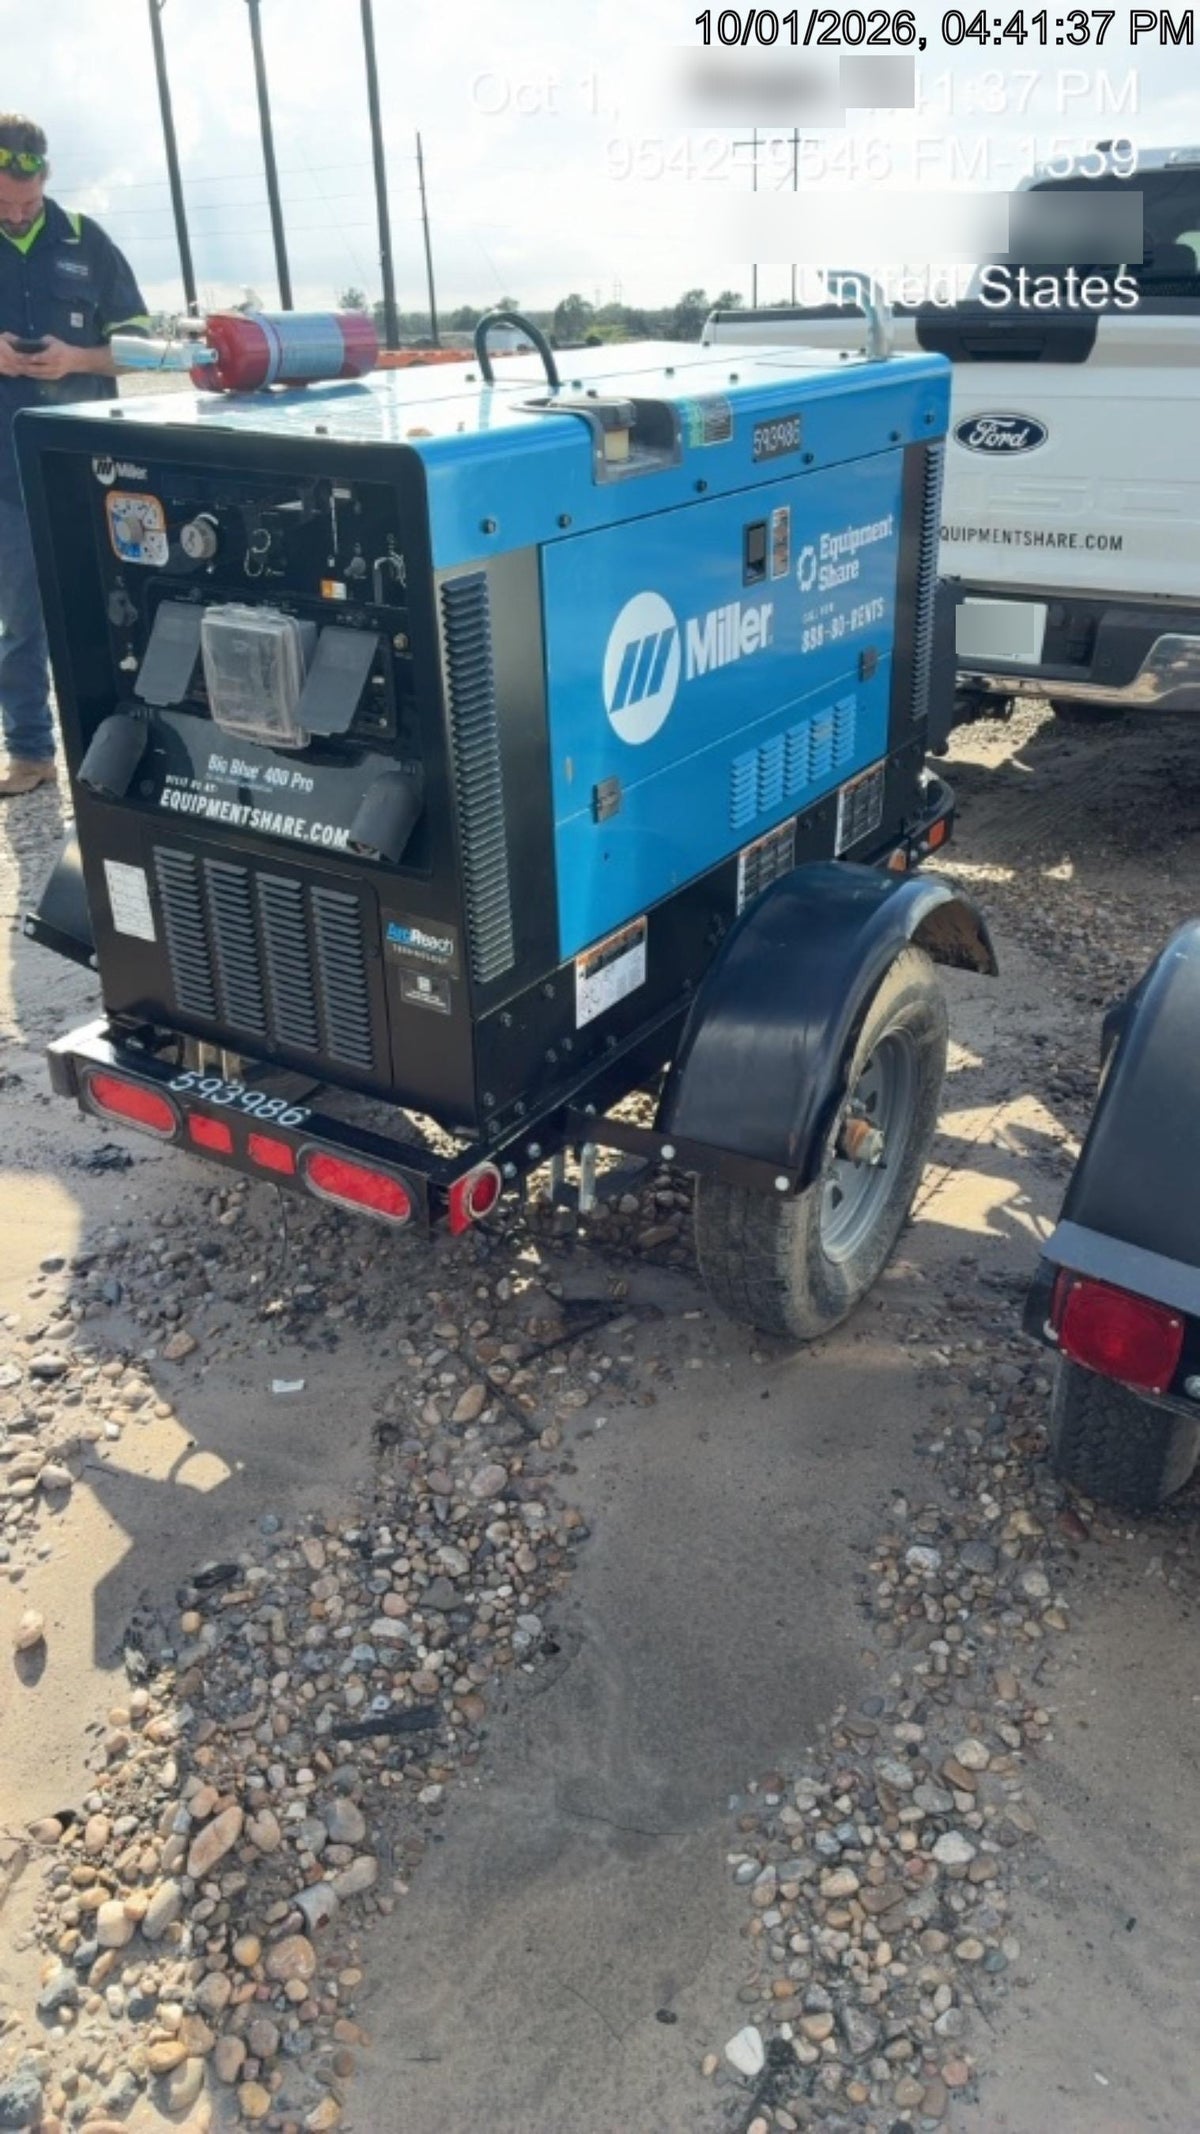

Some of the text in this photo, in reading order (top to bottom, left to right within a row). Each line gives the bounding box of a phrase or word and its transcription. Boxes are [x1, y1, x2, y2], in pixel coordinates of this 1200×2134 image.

[968, 420, 1030, 448] Ford
[114, 461, 148, 480] Miller
[820, 513, 893, 562] Equipment
[937, 526, 1123, 551] QUIPMENTSHARE.COM
[818, 559, 860, 591] Share
[685, 602, 774, 681] Miller
[208, 753, 228, 774] Big
[263, 766, 289, 787] 400
[291, 771, 315, 793] Pro
[160, 788, 351, 849] EQUIPMENTSHARE.COM
[169, 1070, 312, 1126] 593986
